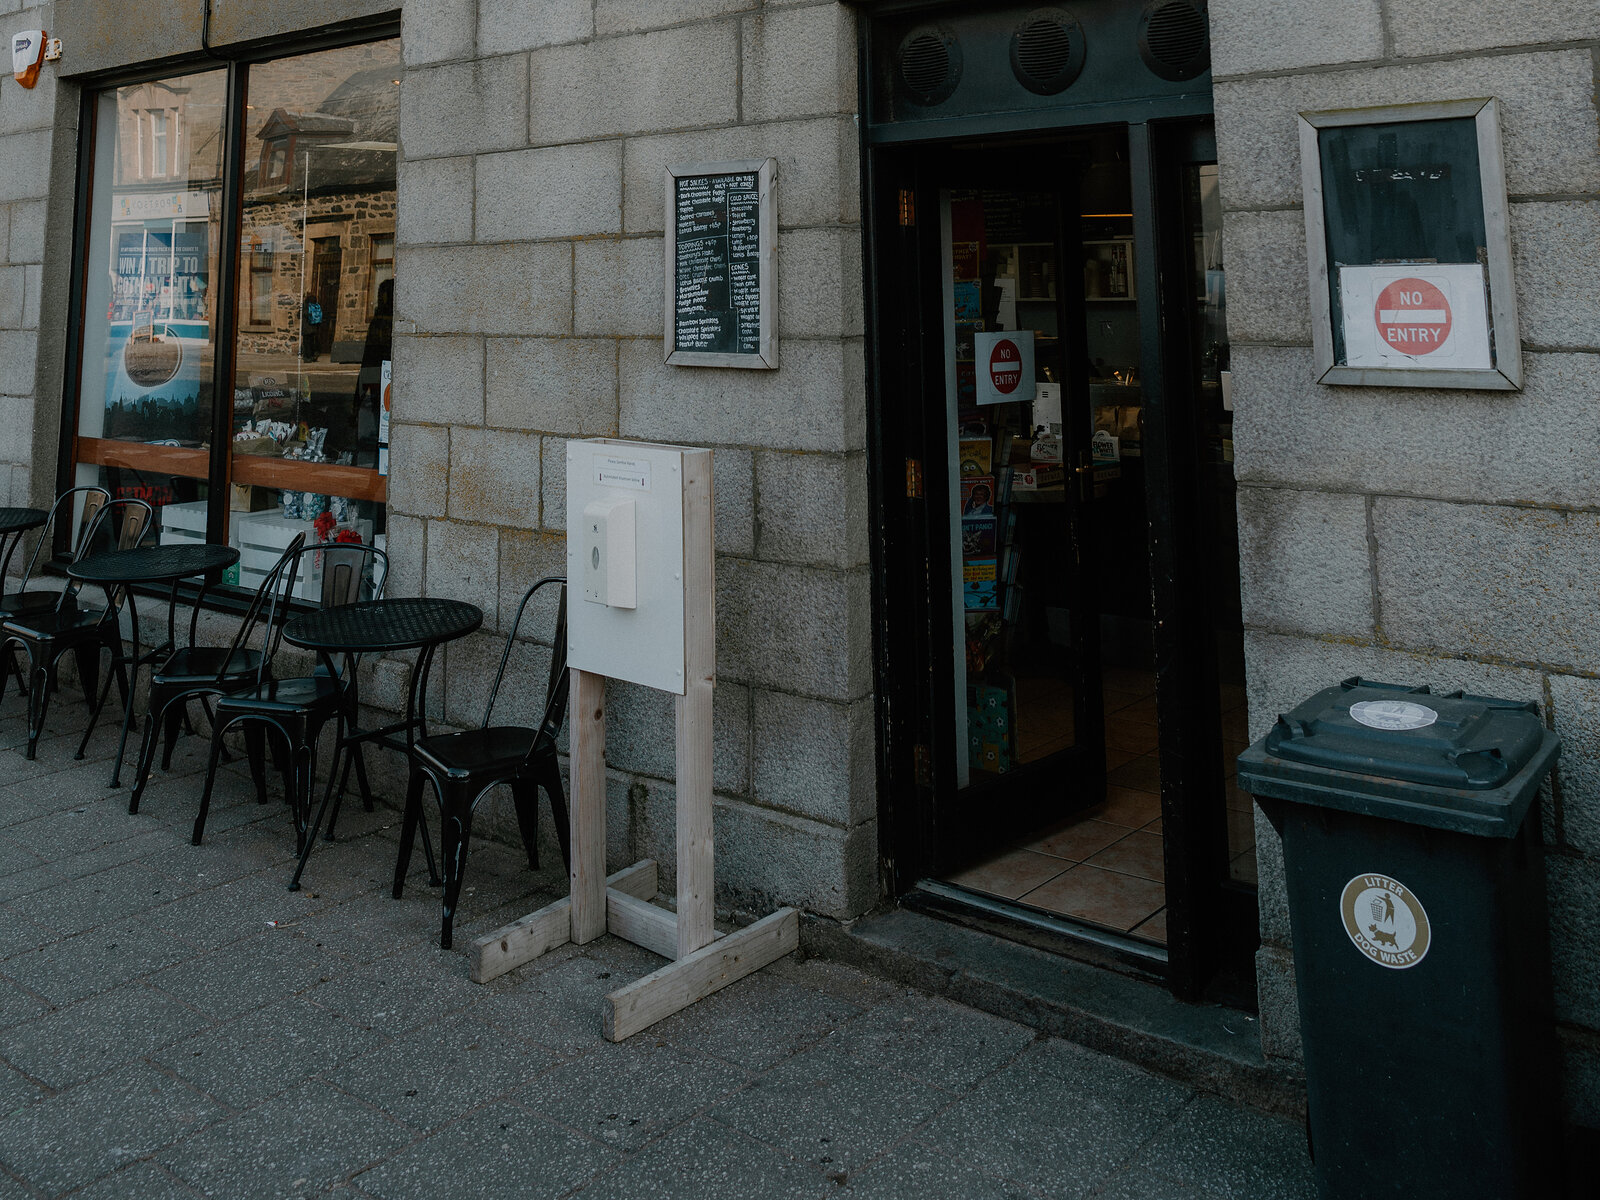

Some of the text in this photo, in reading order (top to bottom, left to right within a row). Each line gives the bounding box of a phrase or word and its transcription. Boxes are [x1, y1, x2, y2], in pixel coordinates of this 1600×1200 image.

[678, 240, 703, 250] TOPPINGS
[119, 257, 136, 275] WIN
[149, 257, 180, 274] TRIP
[183, 257, 199, 274] TO
[1400, 291, 1423, 305] NO
[1387, 328, 1440, 343] ENTRY
[1000, 349, 1011, 359] NO
[995, 373, 1018, 385] ENTRY
[1092, 441, 1114, 449] FLOWER
[1364, 877, 1404, 897] LITTER
[1354, 933, 1417, 964] DOG WASTE
